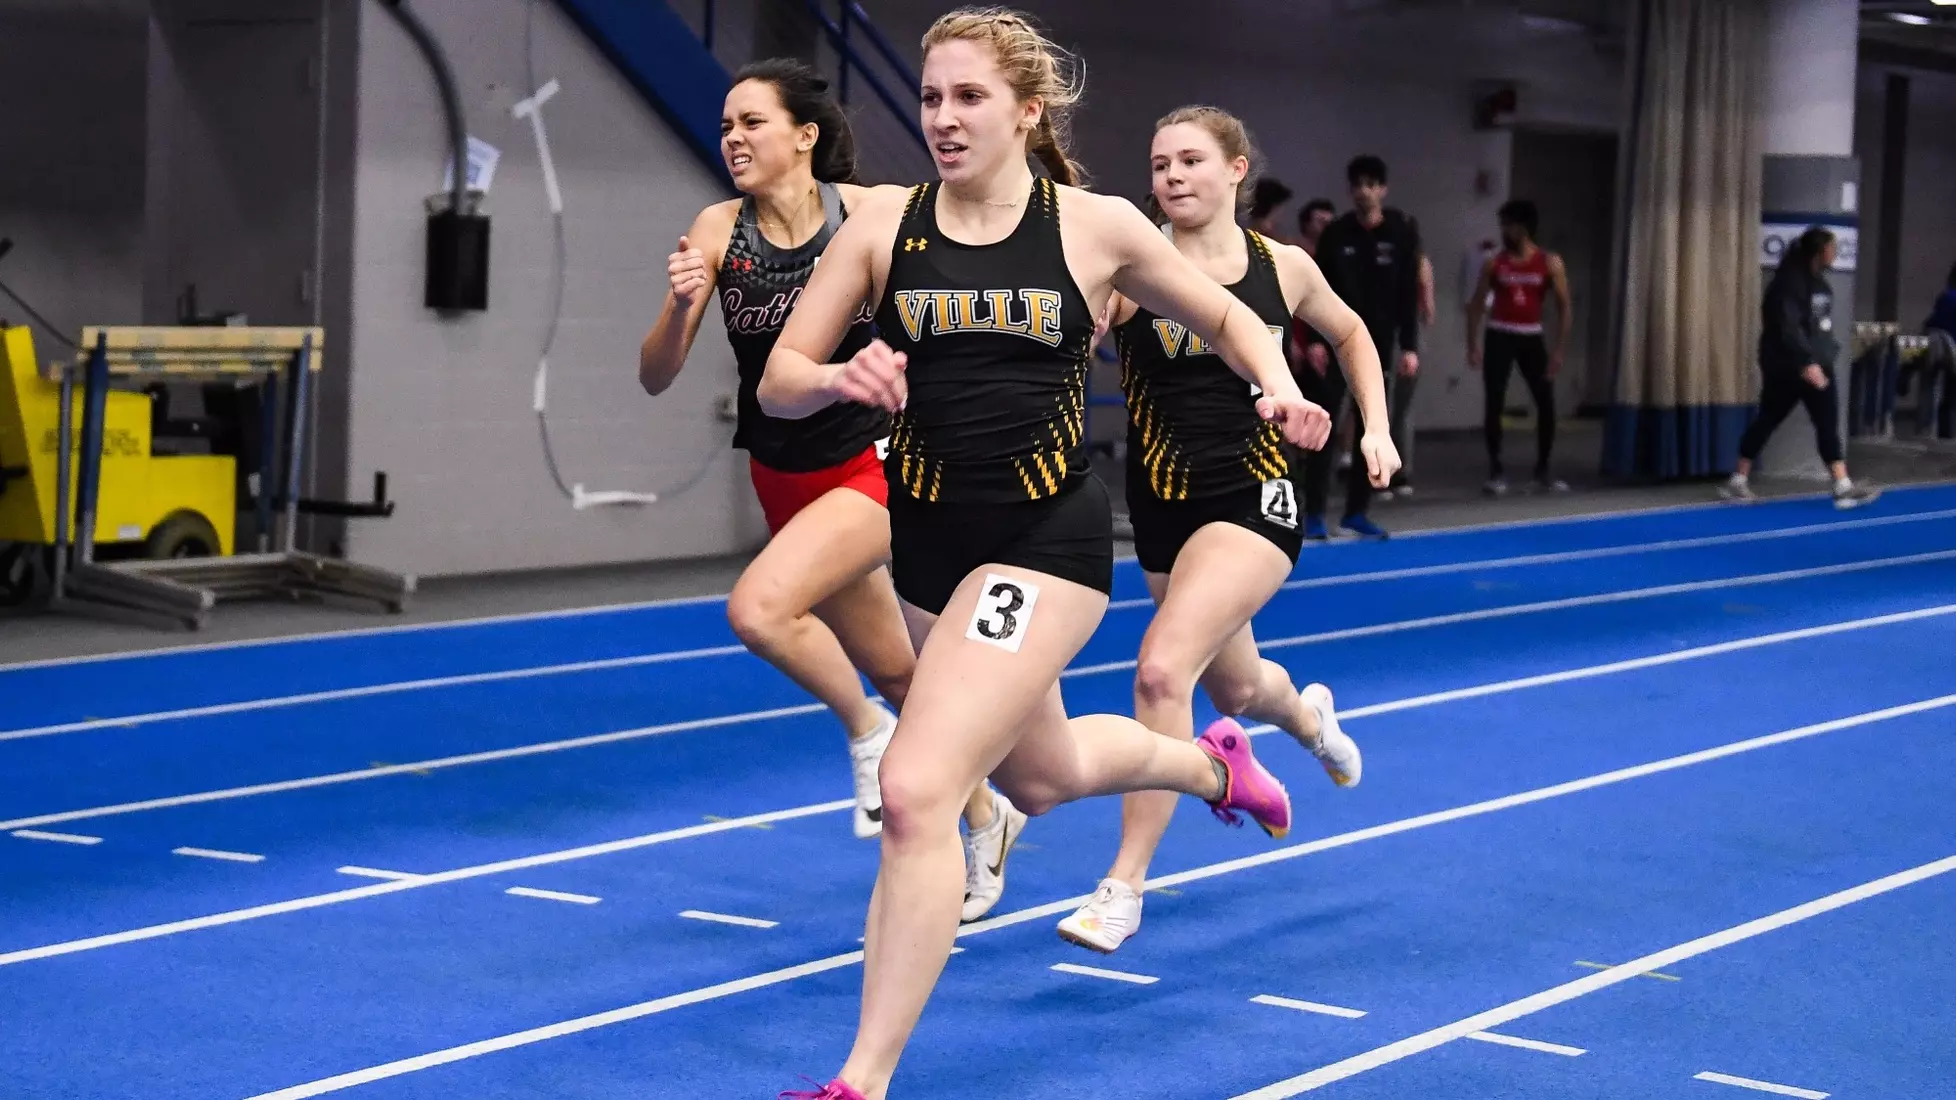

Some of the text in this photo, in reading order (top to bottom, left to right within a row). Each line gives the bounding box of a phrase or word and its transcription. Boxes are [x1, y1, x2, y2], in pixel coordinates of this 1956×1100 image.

[895, 288, 1063, 348] VILLE
[1267, 481, 1292, 522] 4
[977, 583, 1024, 640] 3
